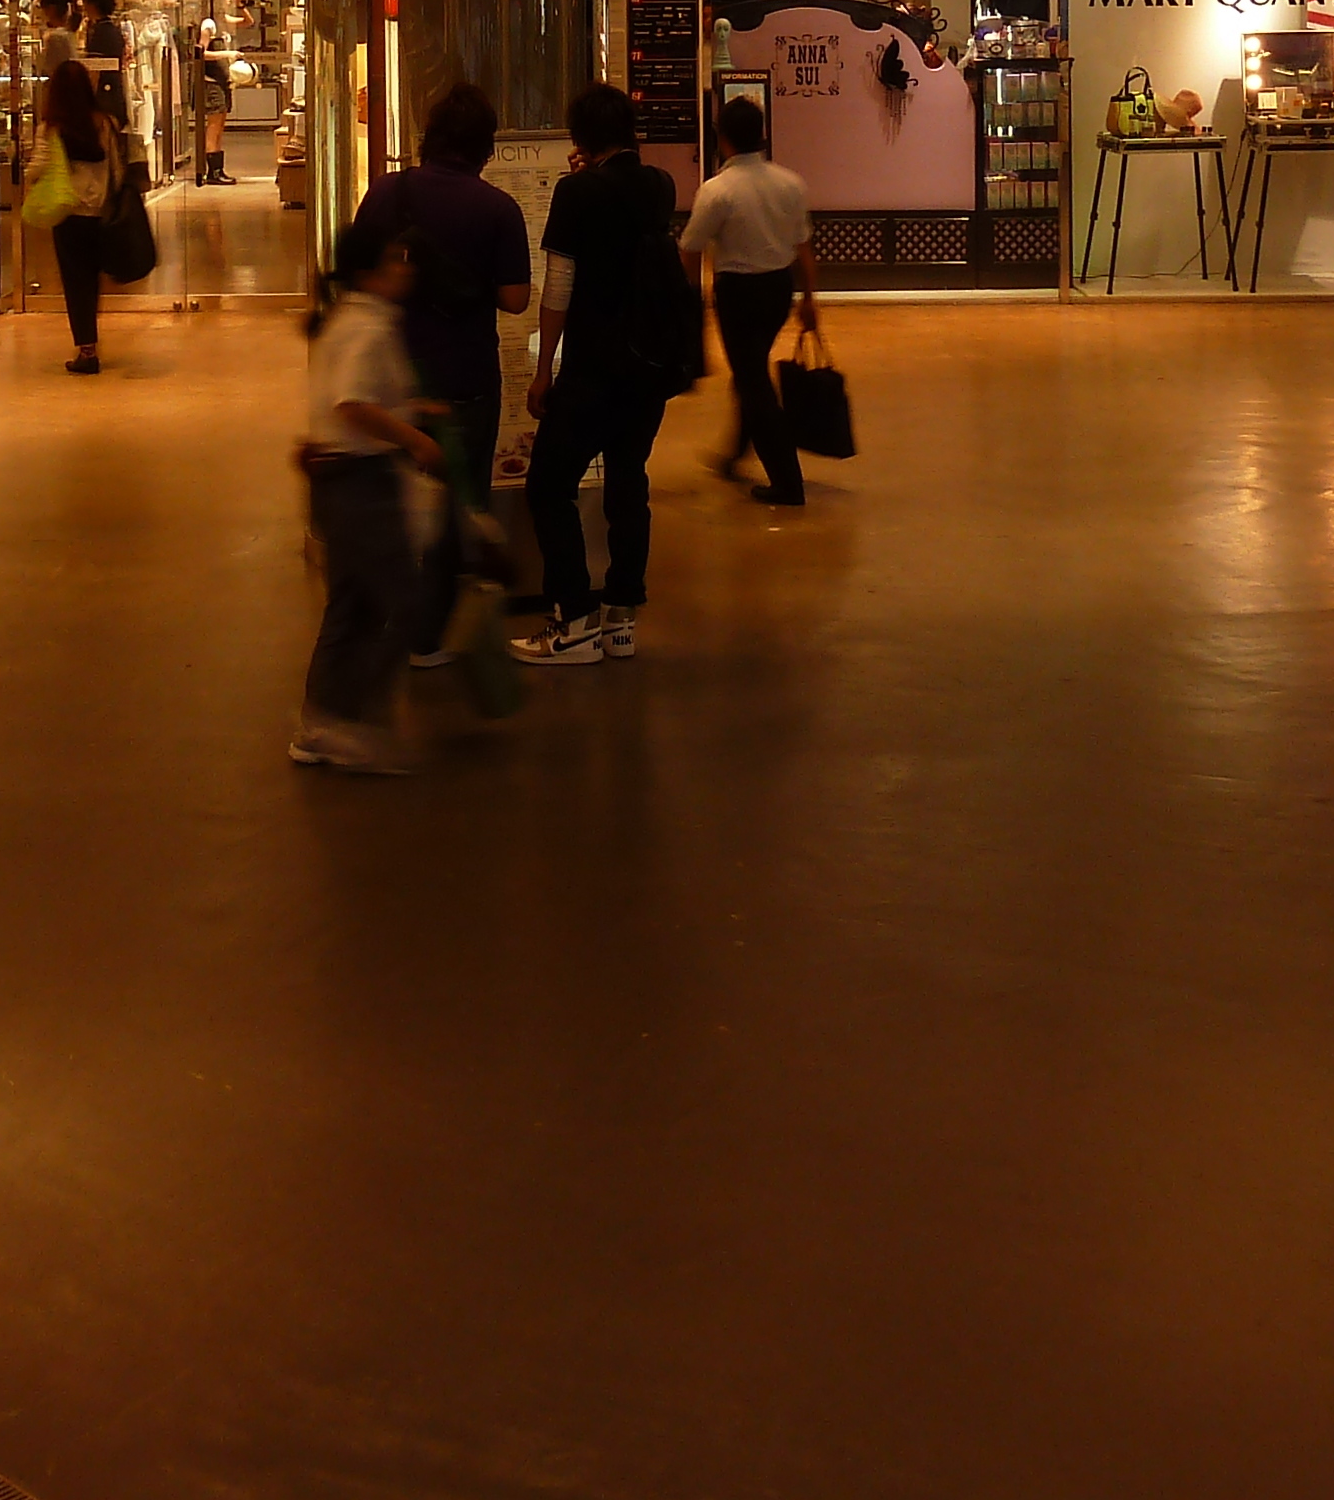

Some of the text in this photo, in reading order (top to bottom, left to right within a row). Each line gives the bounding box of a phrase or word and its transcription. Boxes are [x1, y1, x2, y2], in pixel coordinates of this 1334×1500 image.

[787, 44, 828, 64] ANNA
[795, 66, 820, 86] SUI
[487, 145, 541, 162] ICITY
[612, 635, 634, 646] NIK
